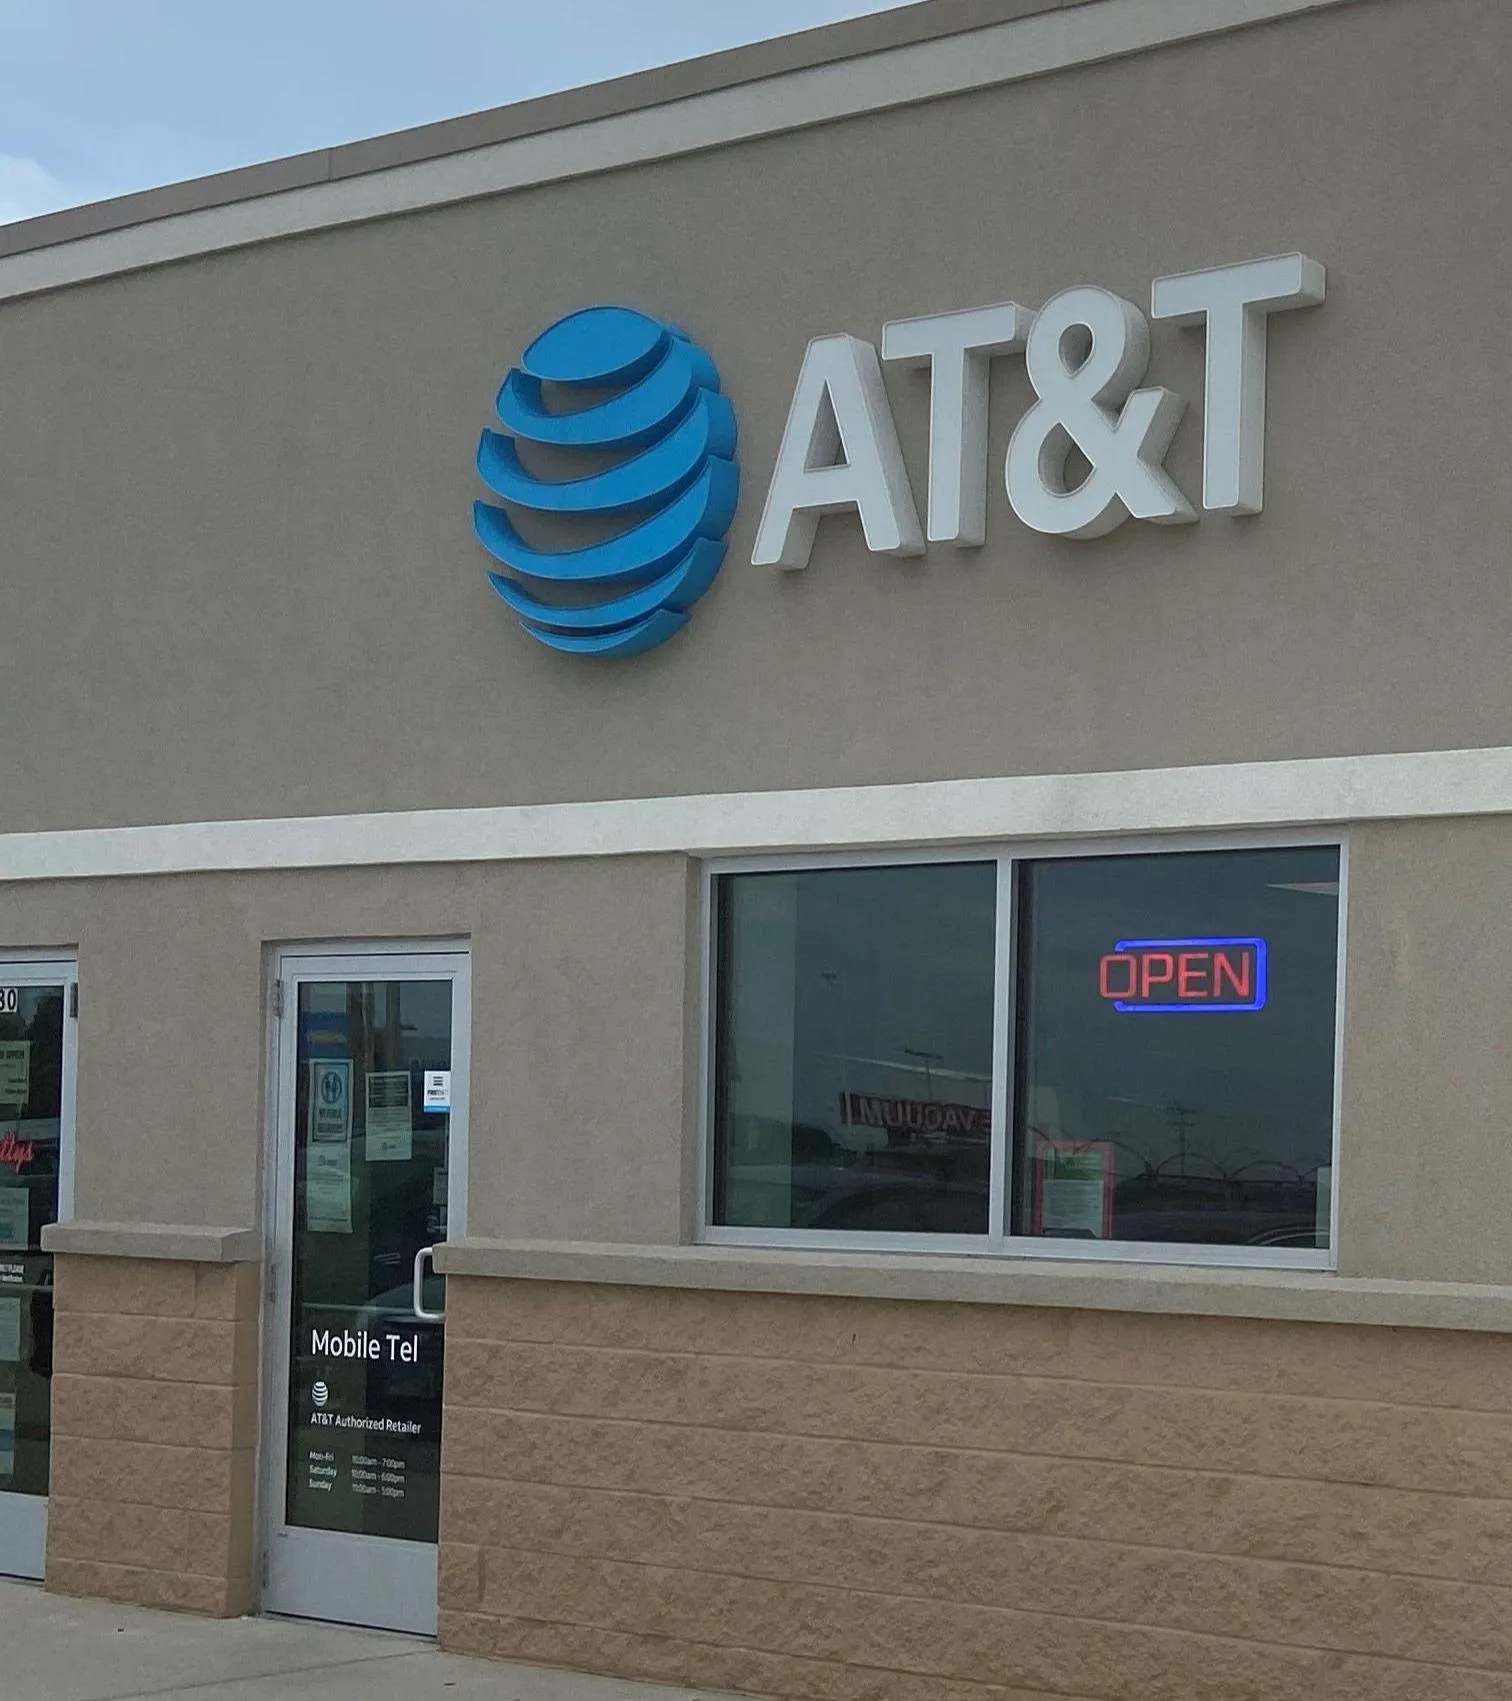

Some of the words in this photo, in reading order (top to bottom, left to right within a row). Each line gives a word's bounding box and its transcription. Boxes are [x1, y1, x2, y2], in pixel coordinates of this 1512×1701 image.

[751, 252, 1327, 571] AT&T
[1100, 951, 1250, 998] OPEN
[312, 1329, 381, 1360] Mobile
[386, 1334, 418, 1362] Tel
[310, 1412, 334, 1425] AT&T
[335, 1414, 385, 1430] Authorized
[386, 1419, 422, 1434] Retailer
[309, 1464, 337, 1478] Saturday
[309, 1479, 333, 1492] Sunday
